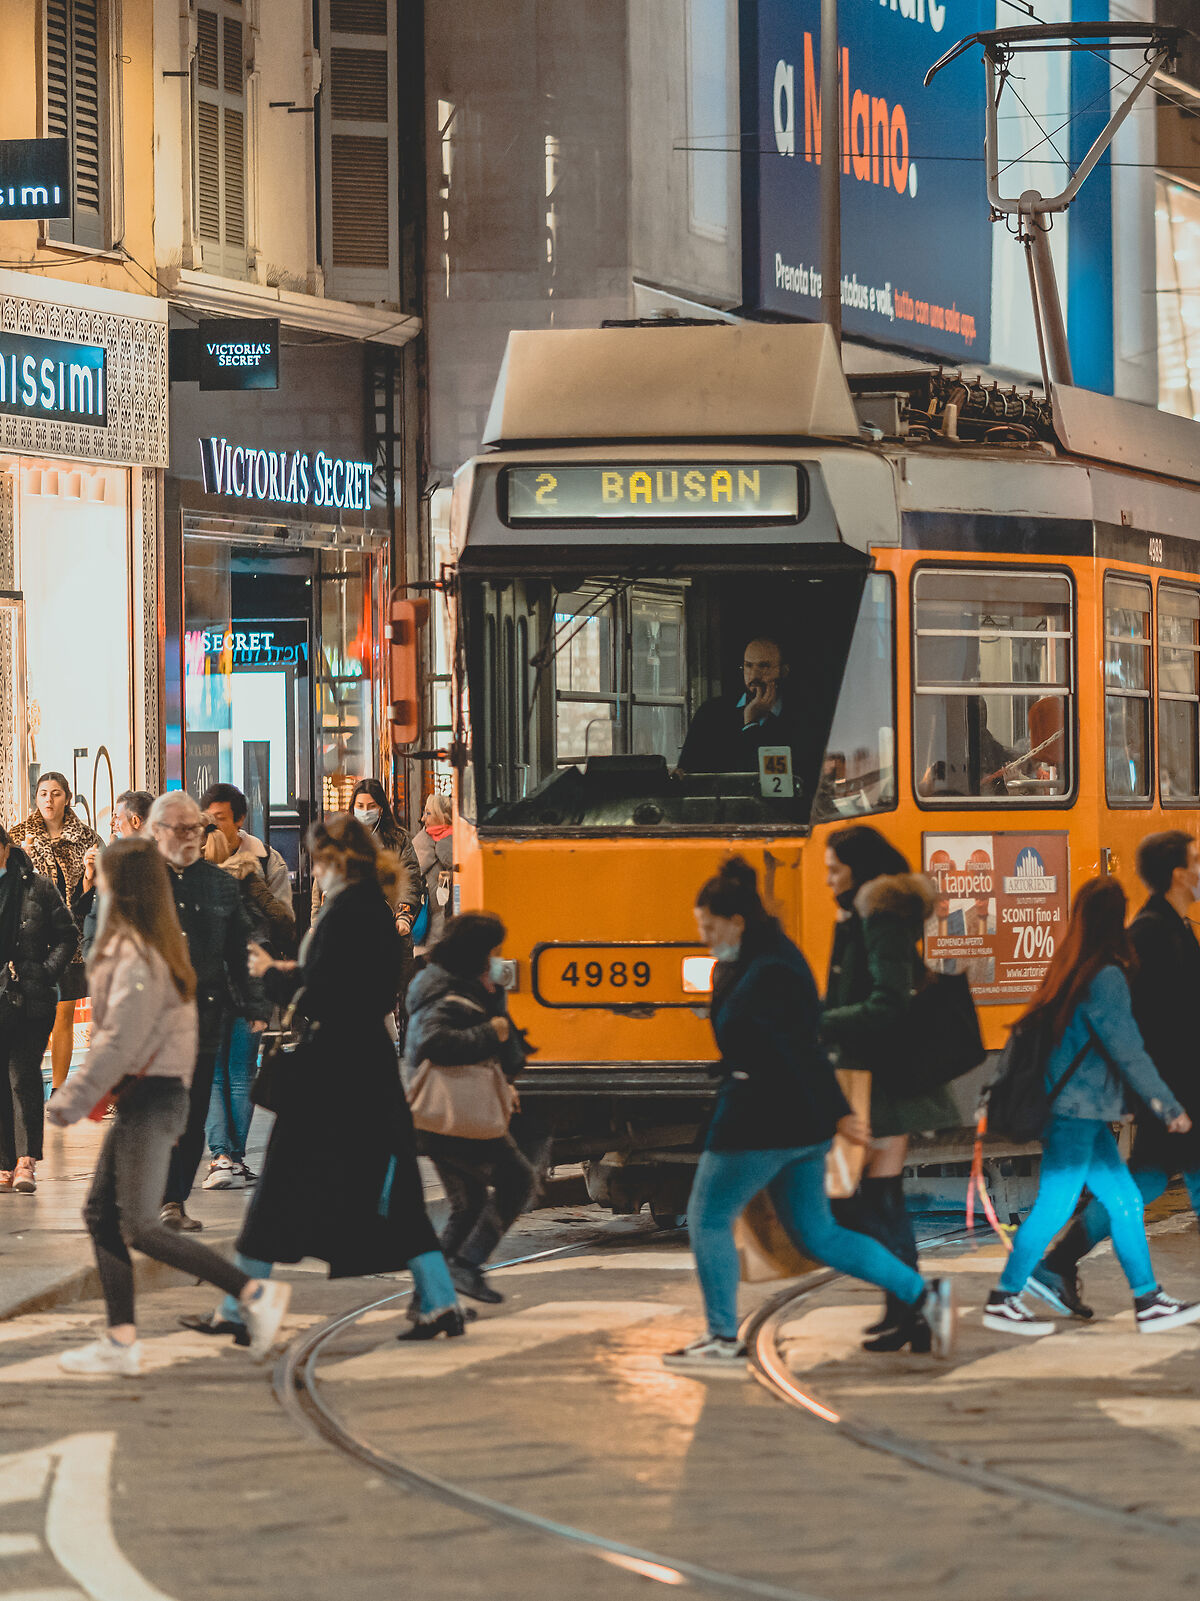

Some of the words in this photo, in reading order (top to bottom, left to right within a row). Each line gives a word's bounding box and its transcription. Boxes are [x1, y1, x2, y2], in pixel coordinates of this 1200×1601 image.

[773, 59, 795, 157] a
[803, 31, 919, 199] Mlano.
[775, 252, 809, 296] Prenota
[869, 287, 876, 313] e
[206, 342, 272, 356] VICTORIA'S
[218, 354, 262, 367] SECRET
[207, 437, 309, 506] VICTORIA'S
[313, 450, 374, 511] SECRET
[535, 472, 559, 505] 2
[601, 469, 761, 505] BAUSAN
[201, 631, 275, 652] SECRET
[772, 776, 782, 793] 2
[944, 872, 993, 899] tappeto
[1007, 878, 1053, 892] ARTORIENT
[1002, 908, 1034, 923] SCONTI
[1035, 908, 1051, 926] fino
[1052, 907, 1061, 923] al
[936, 937, 964, 947] DOMENICA
[964, 936, 984, 946] APERTO
[1012, 925, 1055, 959] 70%
[560, 961, 651, 988] 4989
